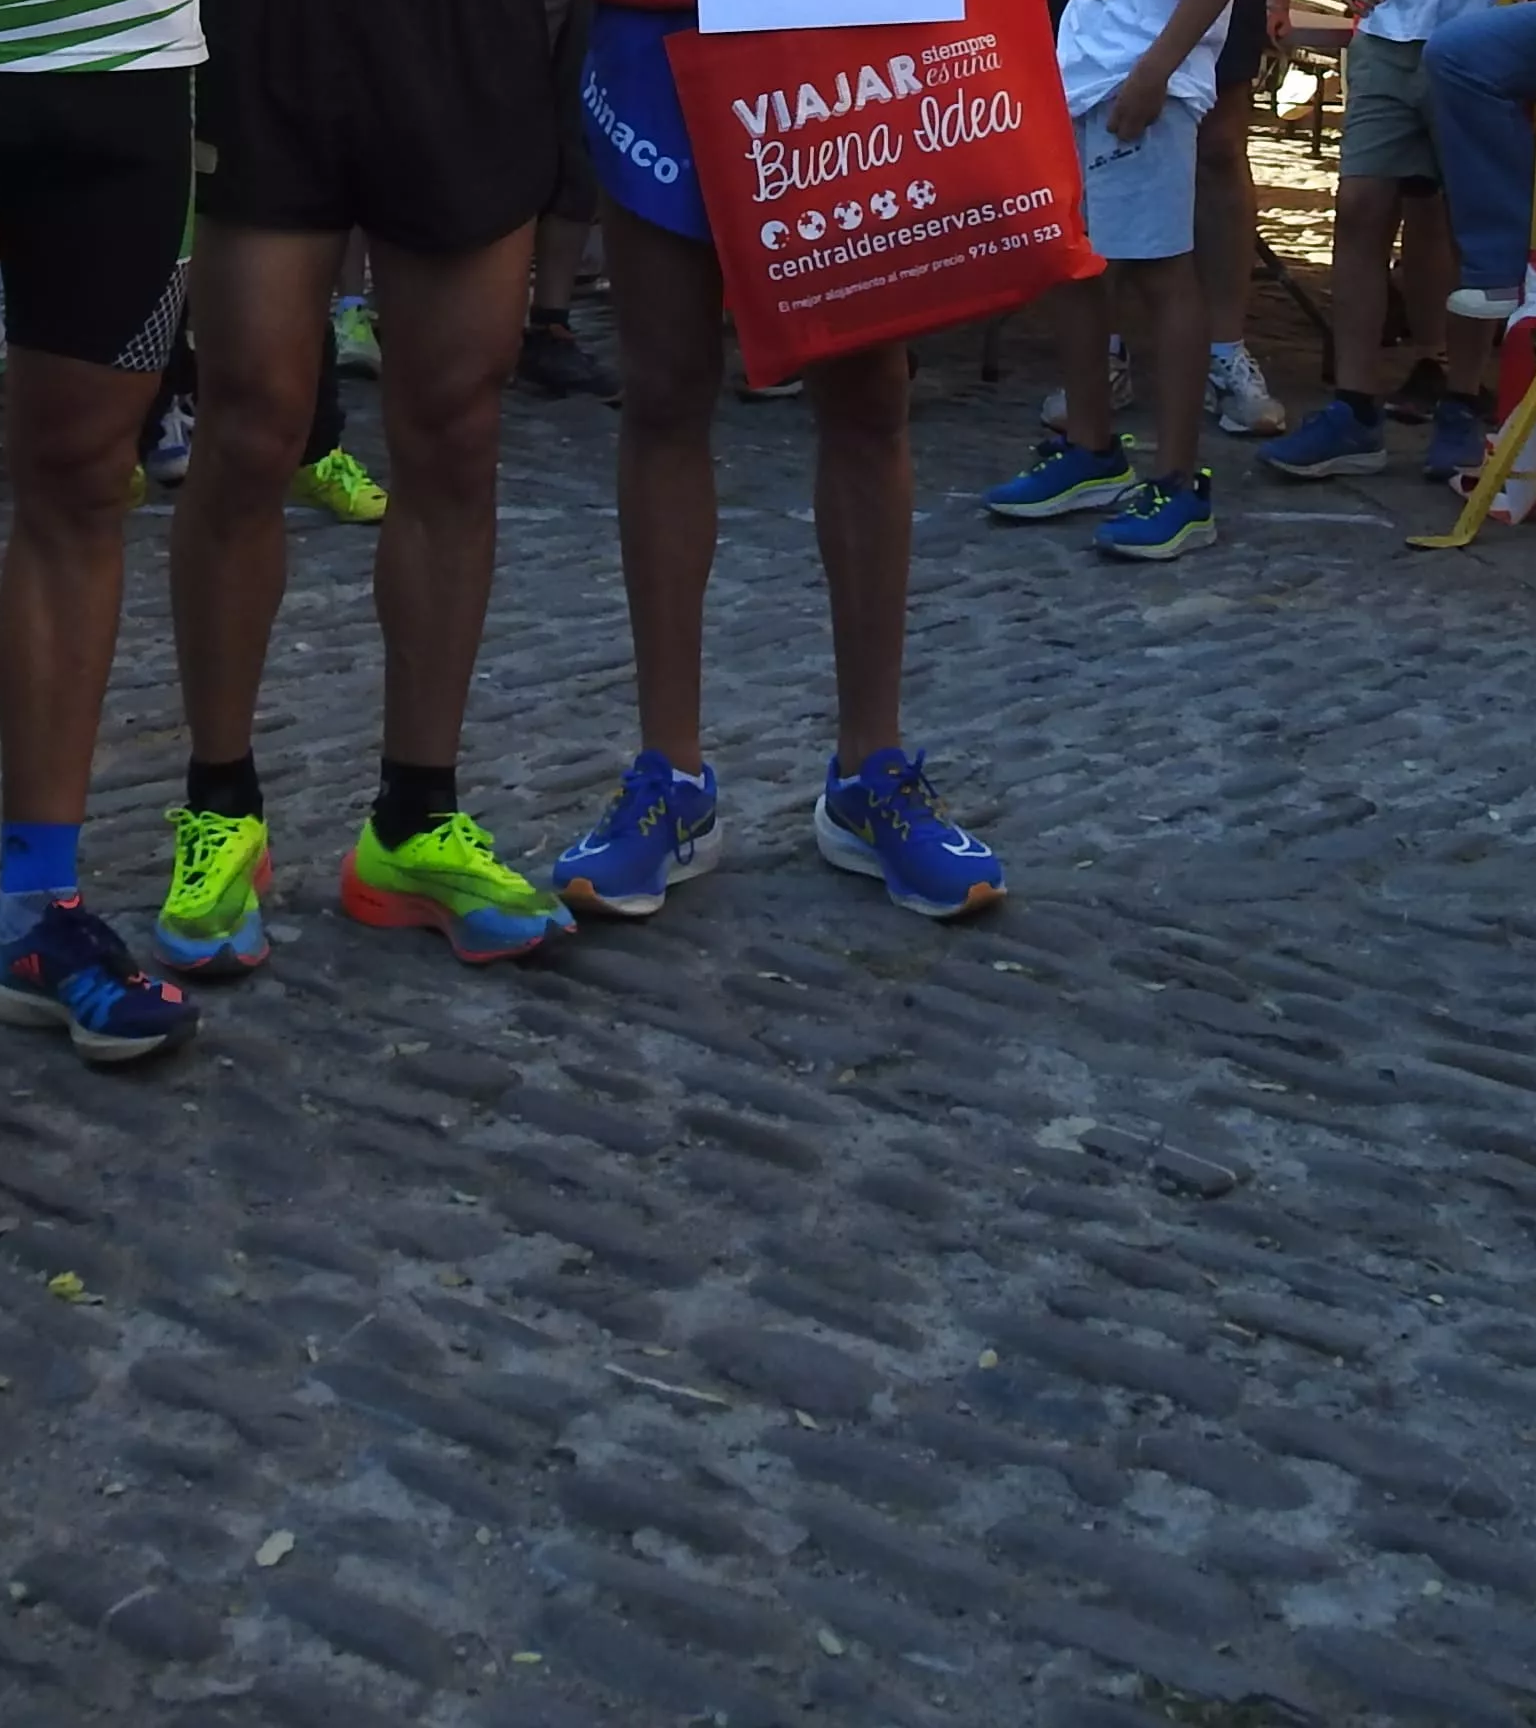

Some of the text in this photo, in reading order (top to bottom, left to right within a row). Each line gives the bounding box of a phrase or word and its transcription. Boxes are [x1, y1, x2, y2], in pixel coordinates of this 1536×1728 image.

[732, 33, 997, 139] VIAJAR siempre
[744, 87, 1022, 203] Buena Idea
[768, 186, 1054, 282] centraldereservas.com
[791, 294, 823, 311] mejor
[825, 276, 887, 301] alojamiento
[899, 262, 930, 280] mejor
[932, 253, 966, 273] precio
[968, 241, 998, 260] 976
[1001, 233, 1030, 251] 301
[1033, 223, 1062, 243] 523
